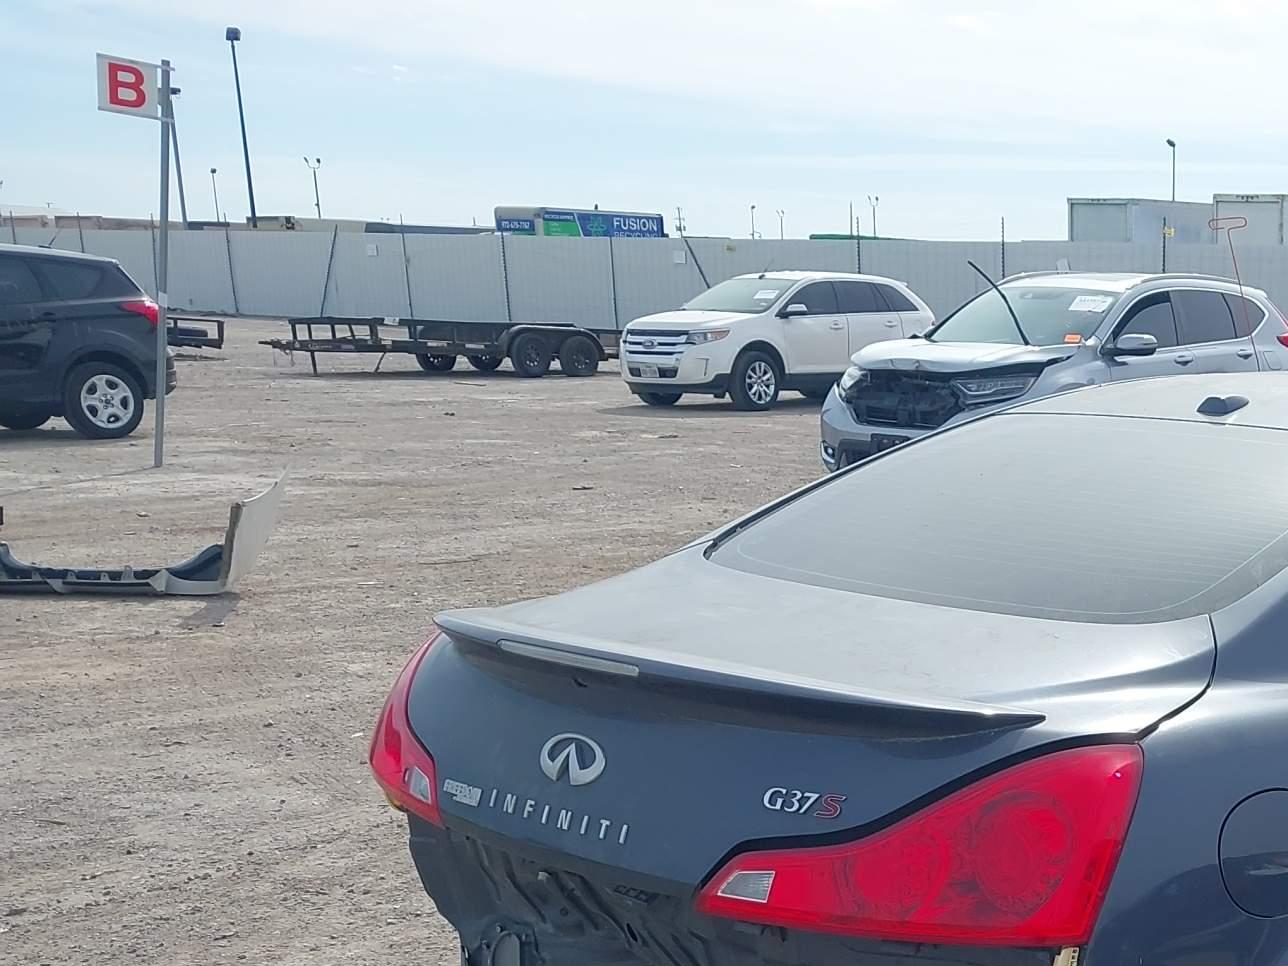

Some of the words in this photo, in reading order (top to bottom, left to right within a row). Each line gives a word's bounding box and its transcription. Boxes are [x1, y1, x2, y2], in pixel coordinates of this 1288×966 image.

[108, 62, 146, 108] B
[613, 217, 657, 232] FUSION
[488, 788, 630, 845] INFINITI
